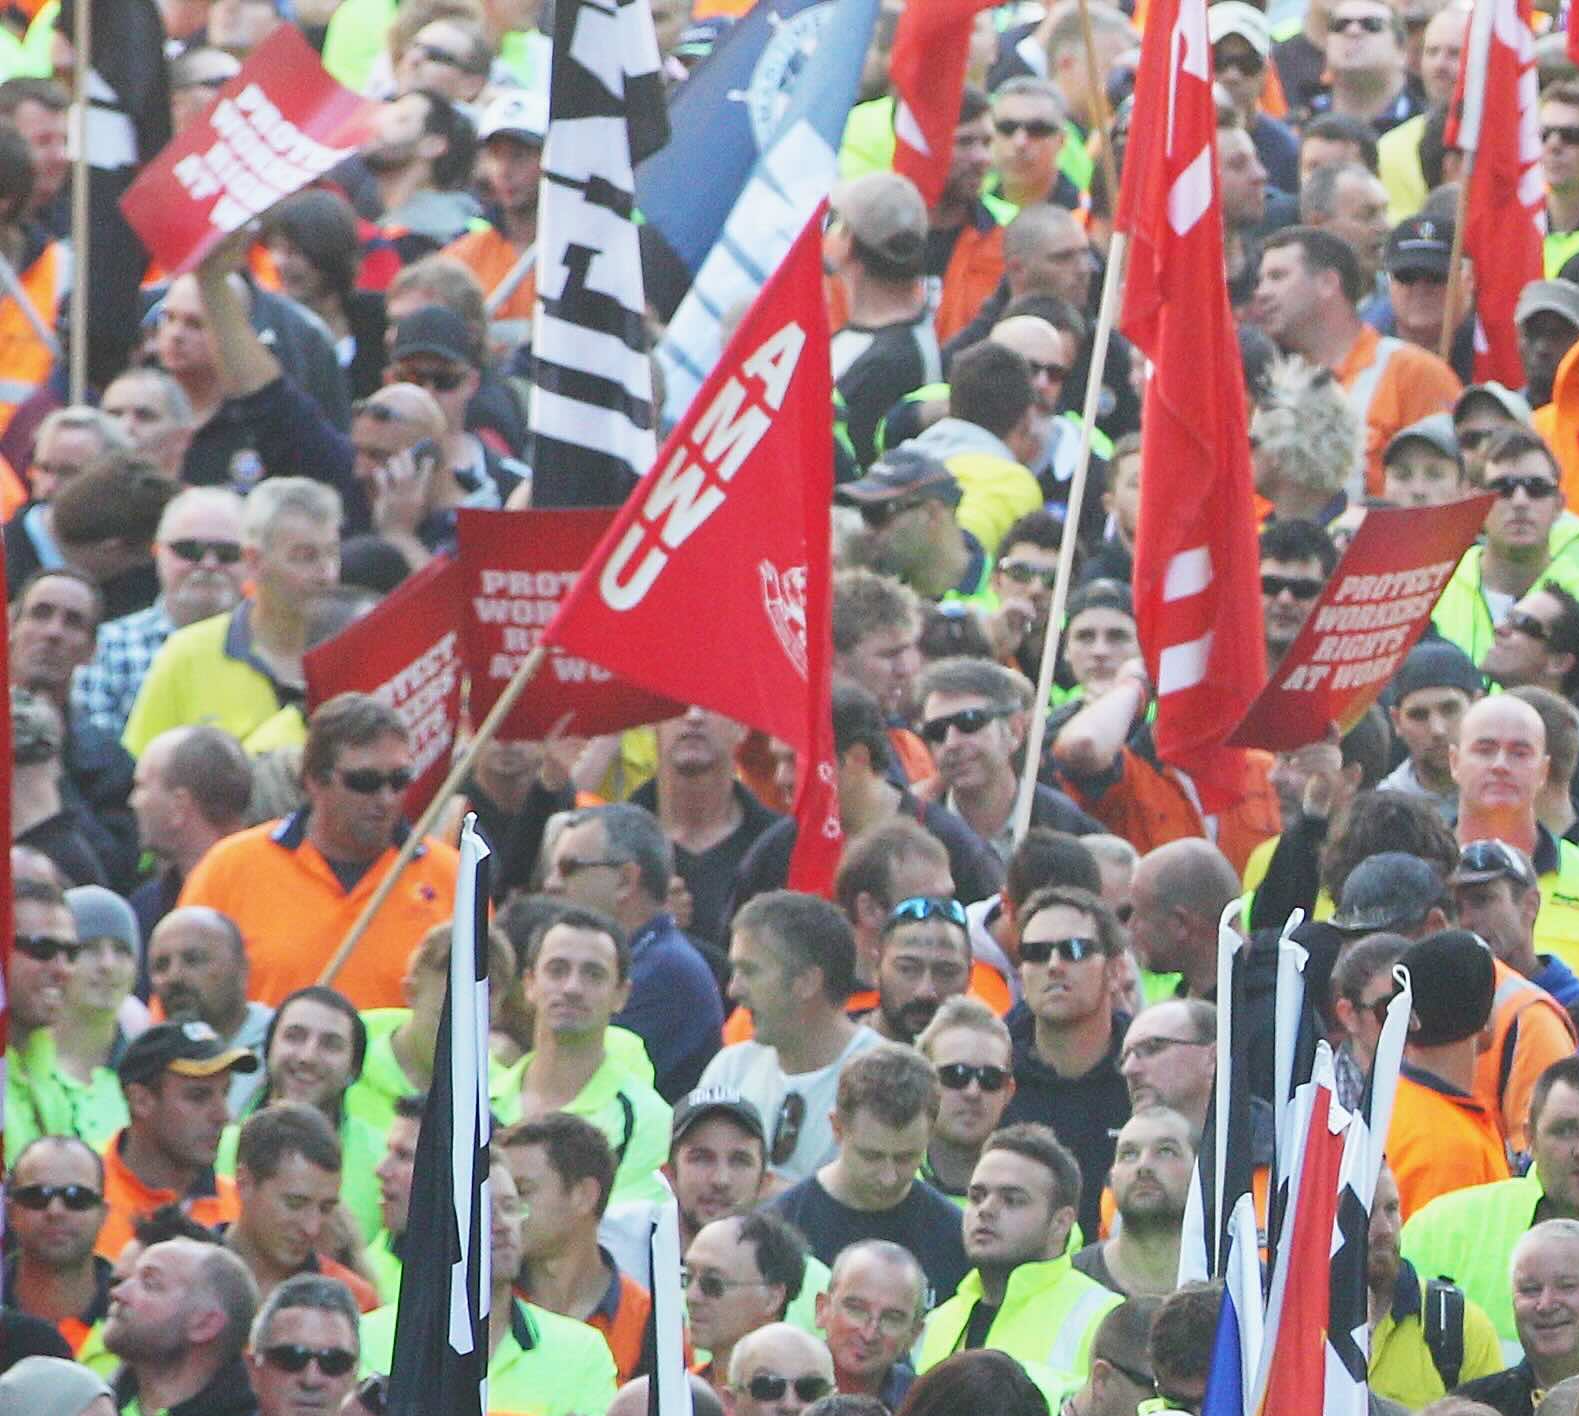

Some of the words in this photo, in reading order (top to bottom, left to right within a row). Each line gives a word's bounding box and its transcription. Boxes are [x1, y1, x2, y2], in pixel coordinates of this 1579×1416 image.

[600, 321, 806, 612] AMWU
[480, 569, 580, 597] PROT
[1281, 665, 1331, 691] AT
